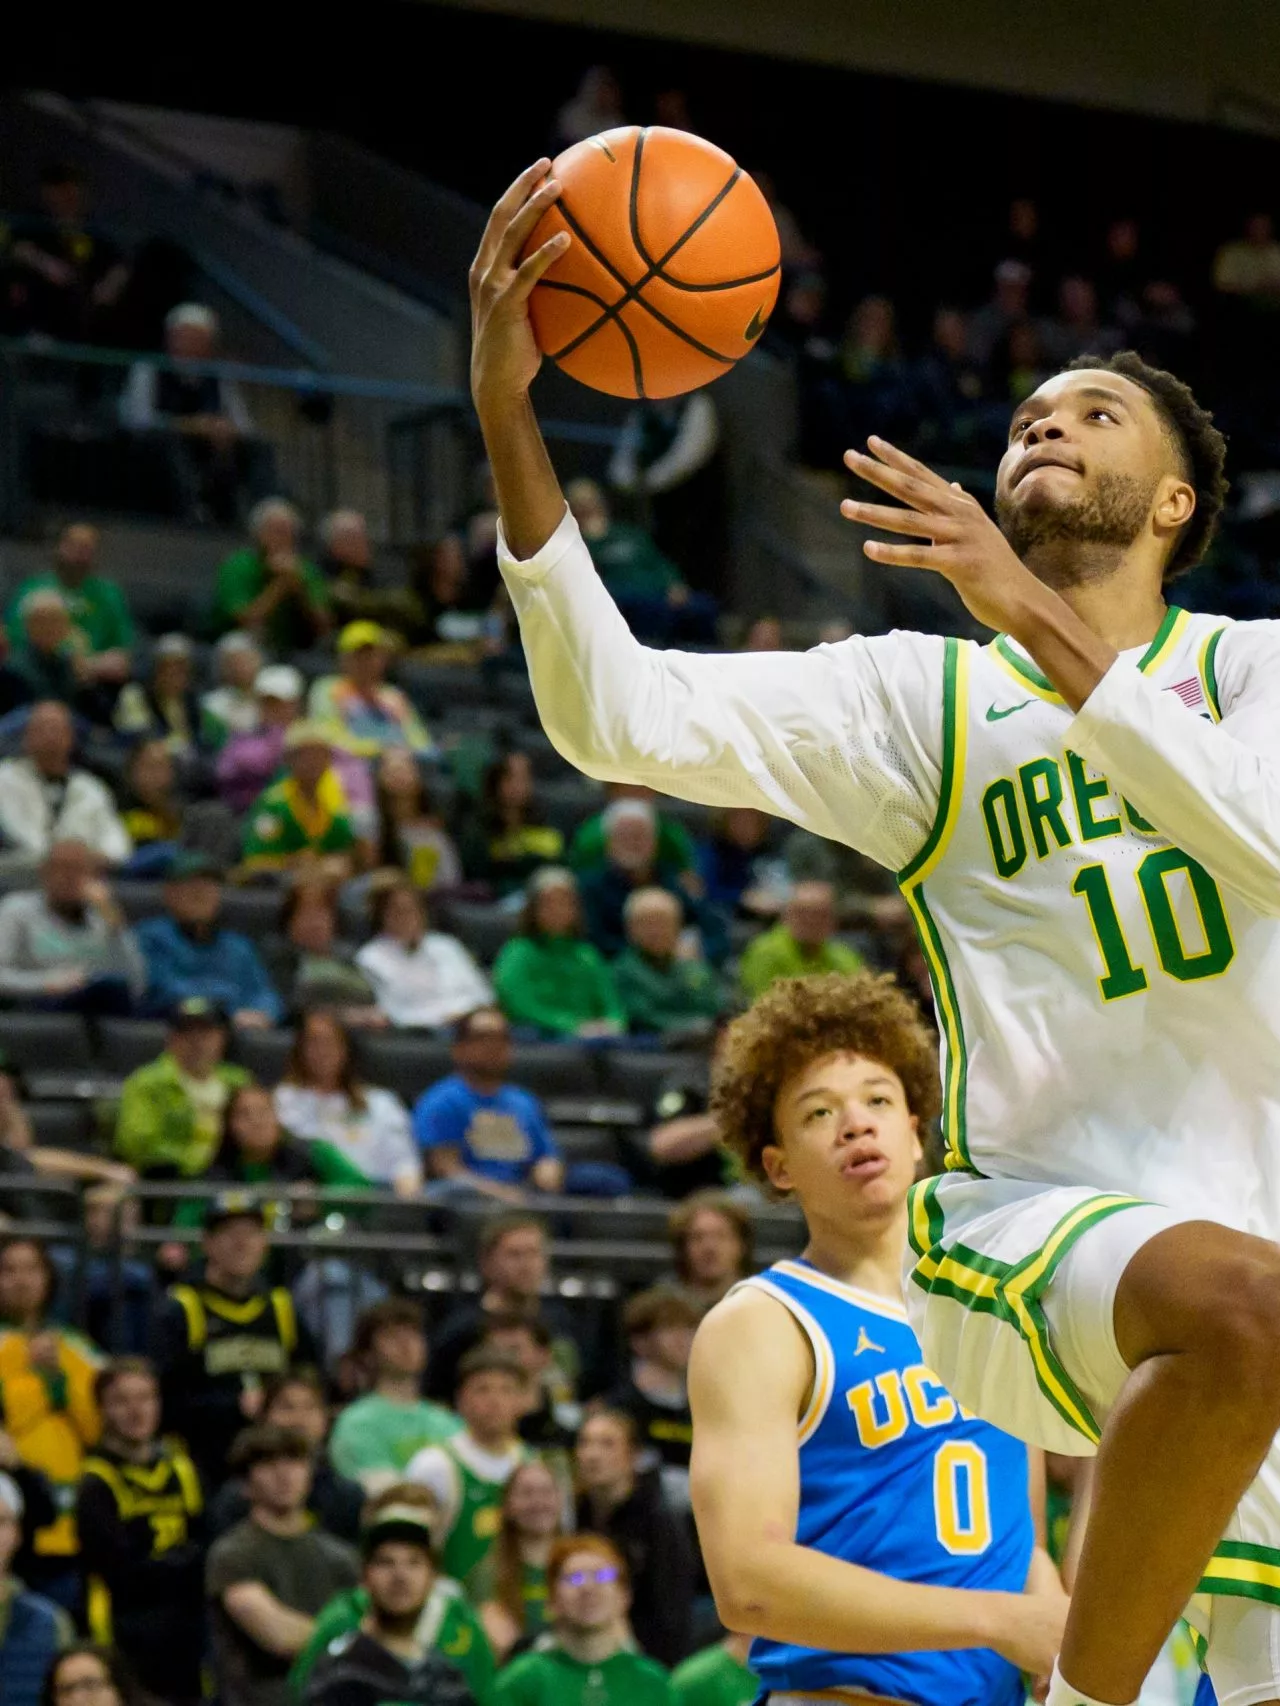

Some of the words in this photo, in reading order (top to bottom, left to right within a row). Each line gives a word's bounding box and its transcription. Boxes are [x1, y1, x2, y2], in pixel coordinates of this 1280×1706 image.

[980, 748, 1169, 880] ORE
[1071, 846, 1236, 1005] 10
[846, 1363, 978, 1450] UC
[933, 1440, 992, 1556] 0
